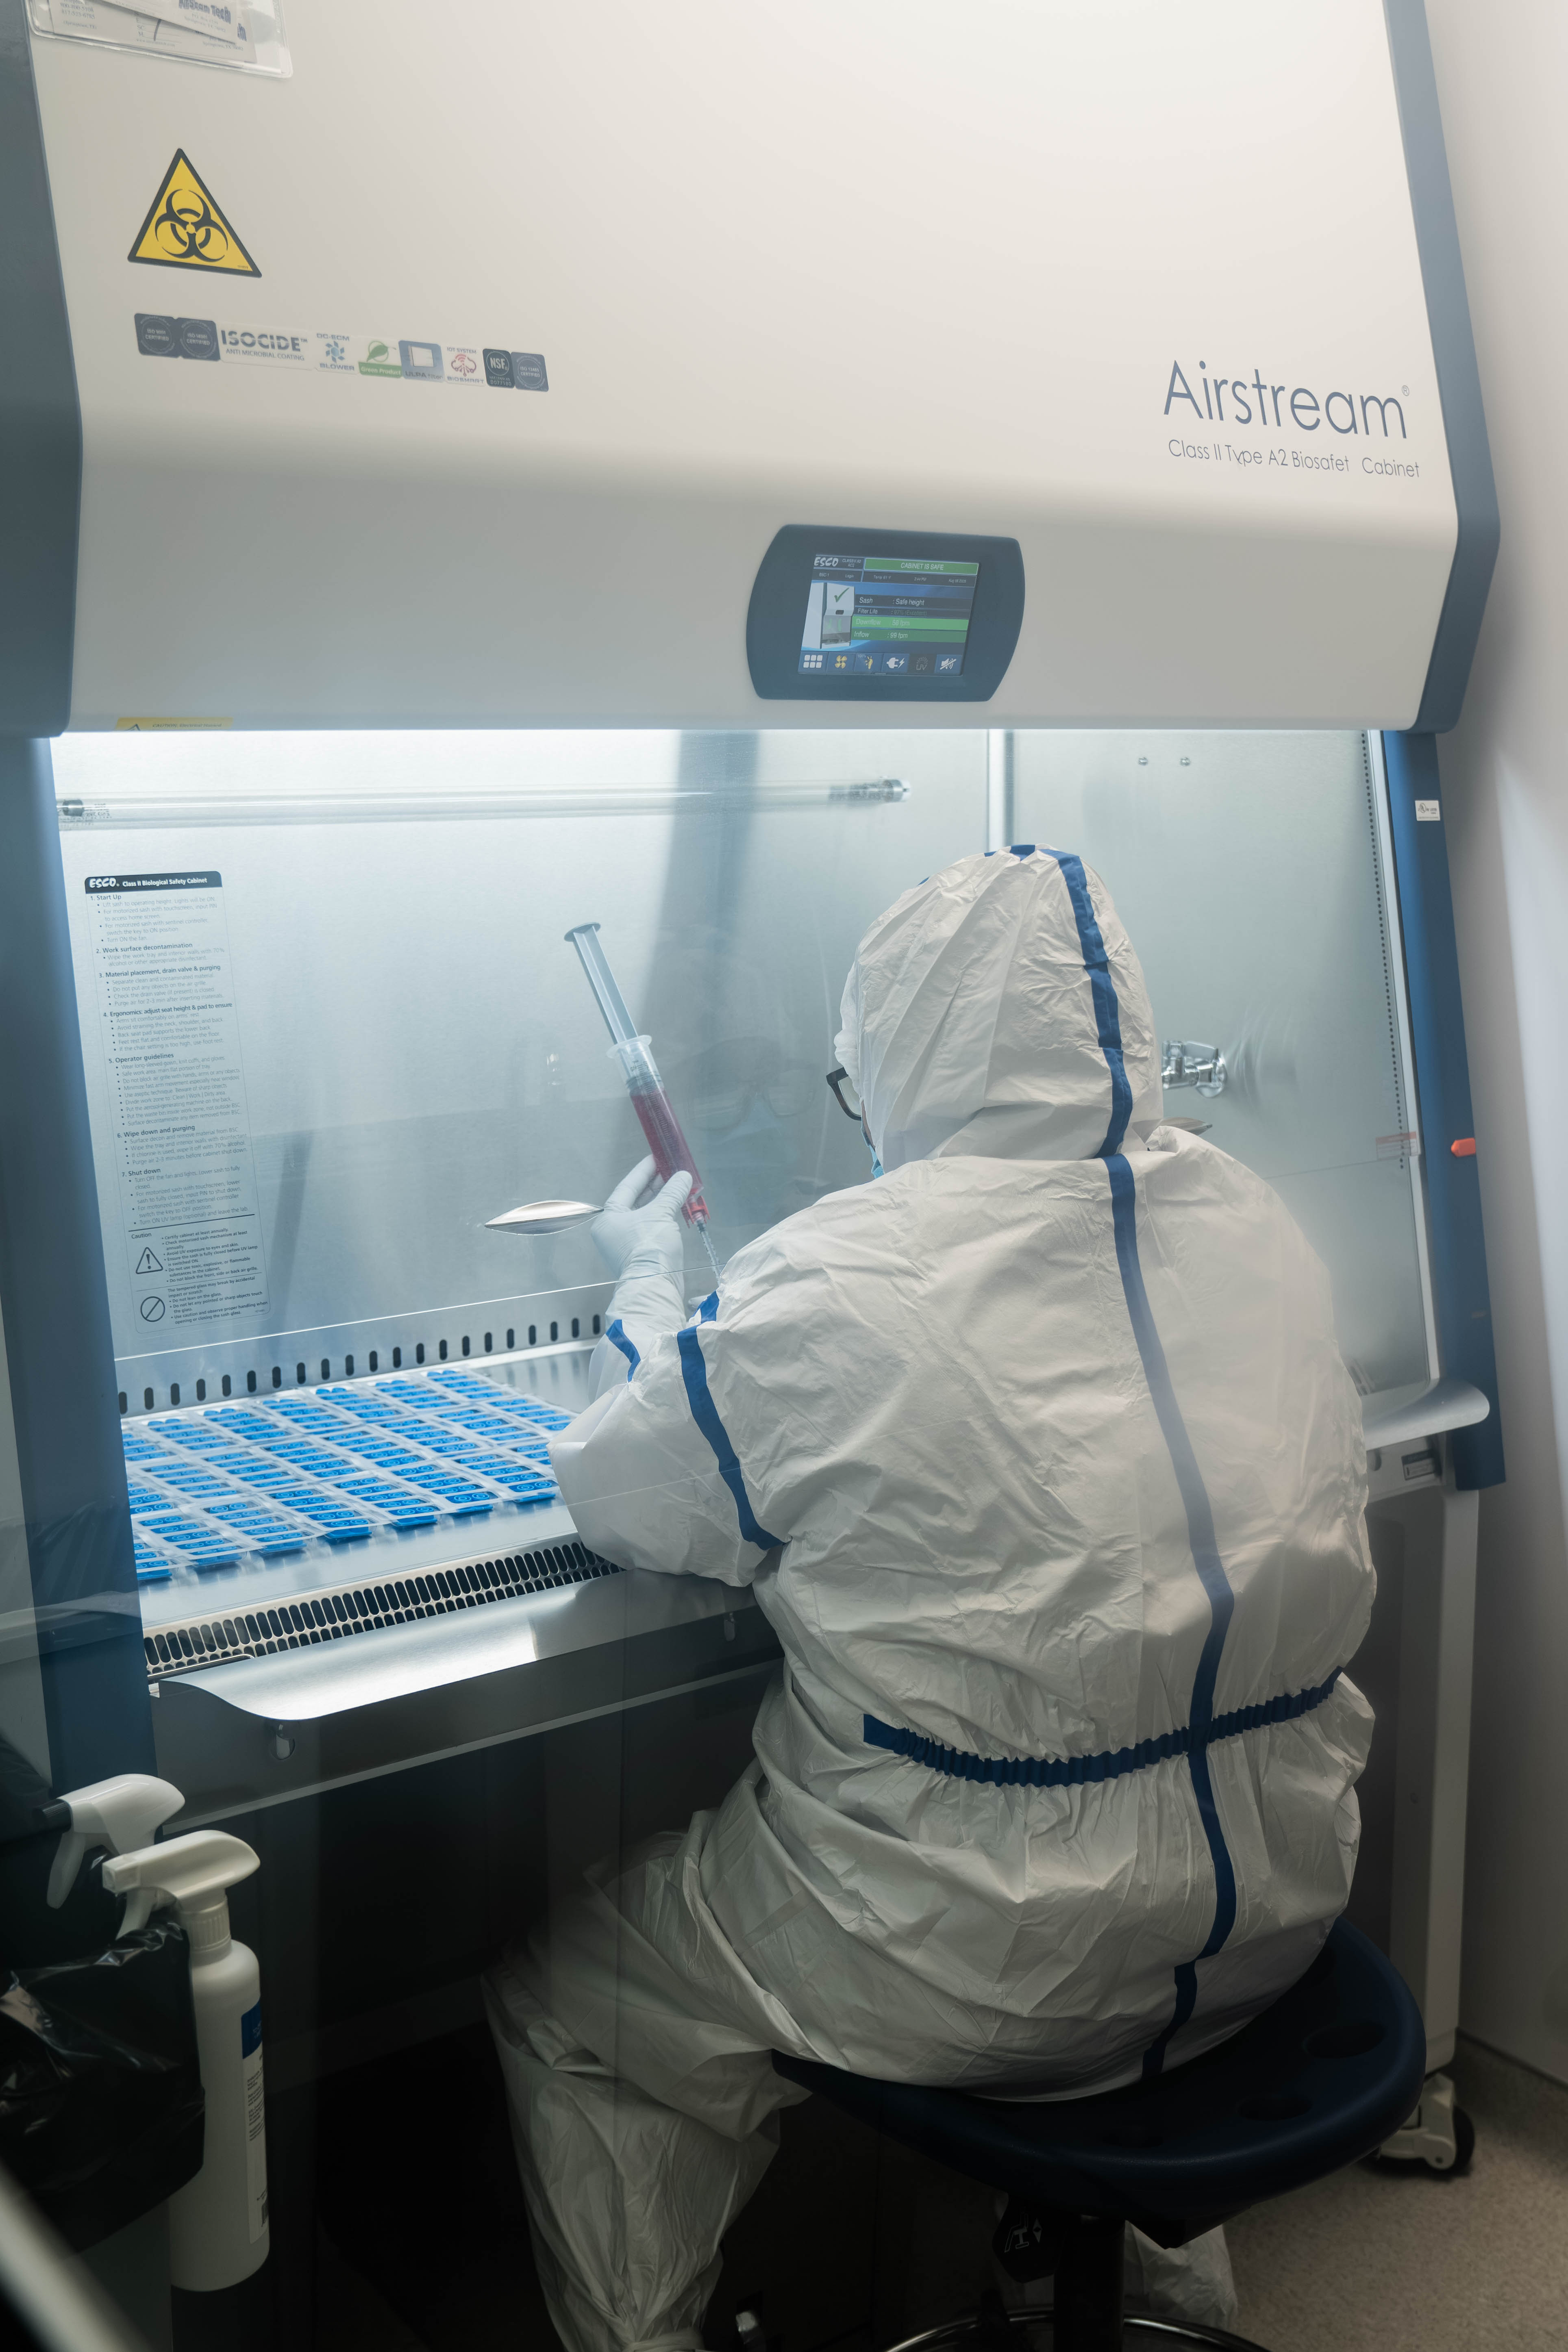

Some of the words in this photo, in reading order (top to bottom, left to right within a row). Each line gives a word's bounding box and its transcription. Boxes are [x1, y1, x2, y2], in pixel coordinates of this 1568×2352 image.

[242, 350, 276, 359] MICROBIAL
[277, 353, 304, 361] COATING
[320, 363, 354, 371] BLOWER
[1168, 439, 1210, 460] Class
[1214, 443, 1221, 461] II
[1224, 445, 1263, 467] Type
[1268, 448, 1289, 467] A2
[1362, 457, 1420, 478] Cabinet
[814, 557, 839, 567] ESCO
[909, 599, 925, 607] height
[90, 878, 116, 888] ESCO
[109, 1009, 143, 1018] Ergonomics:
